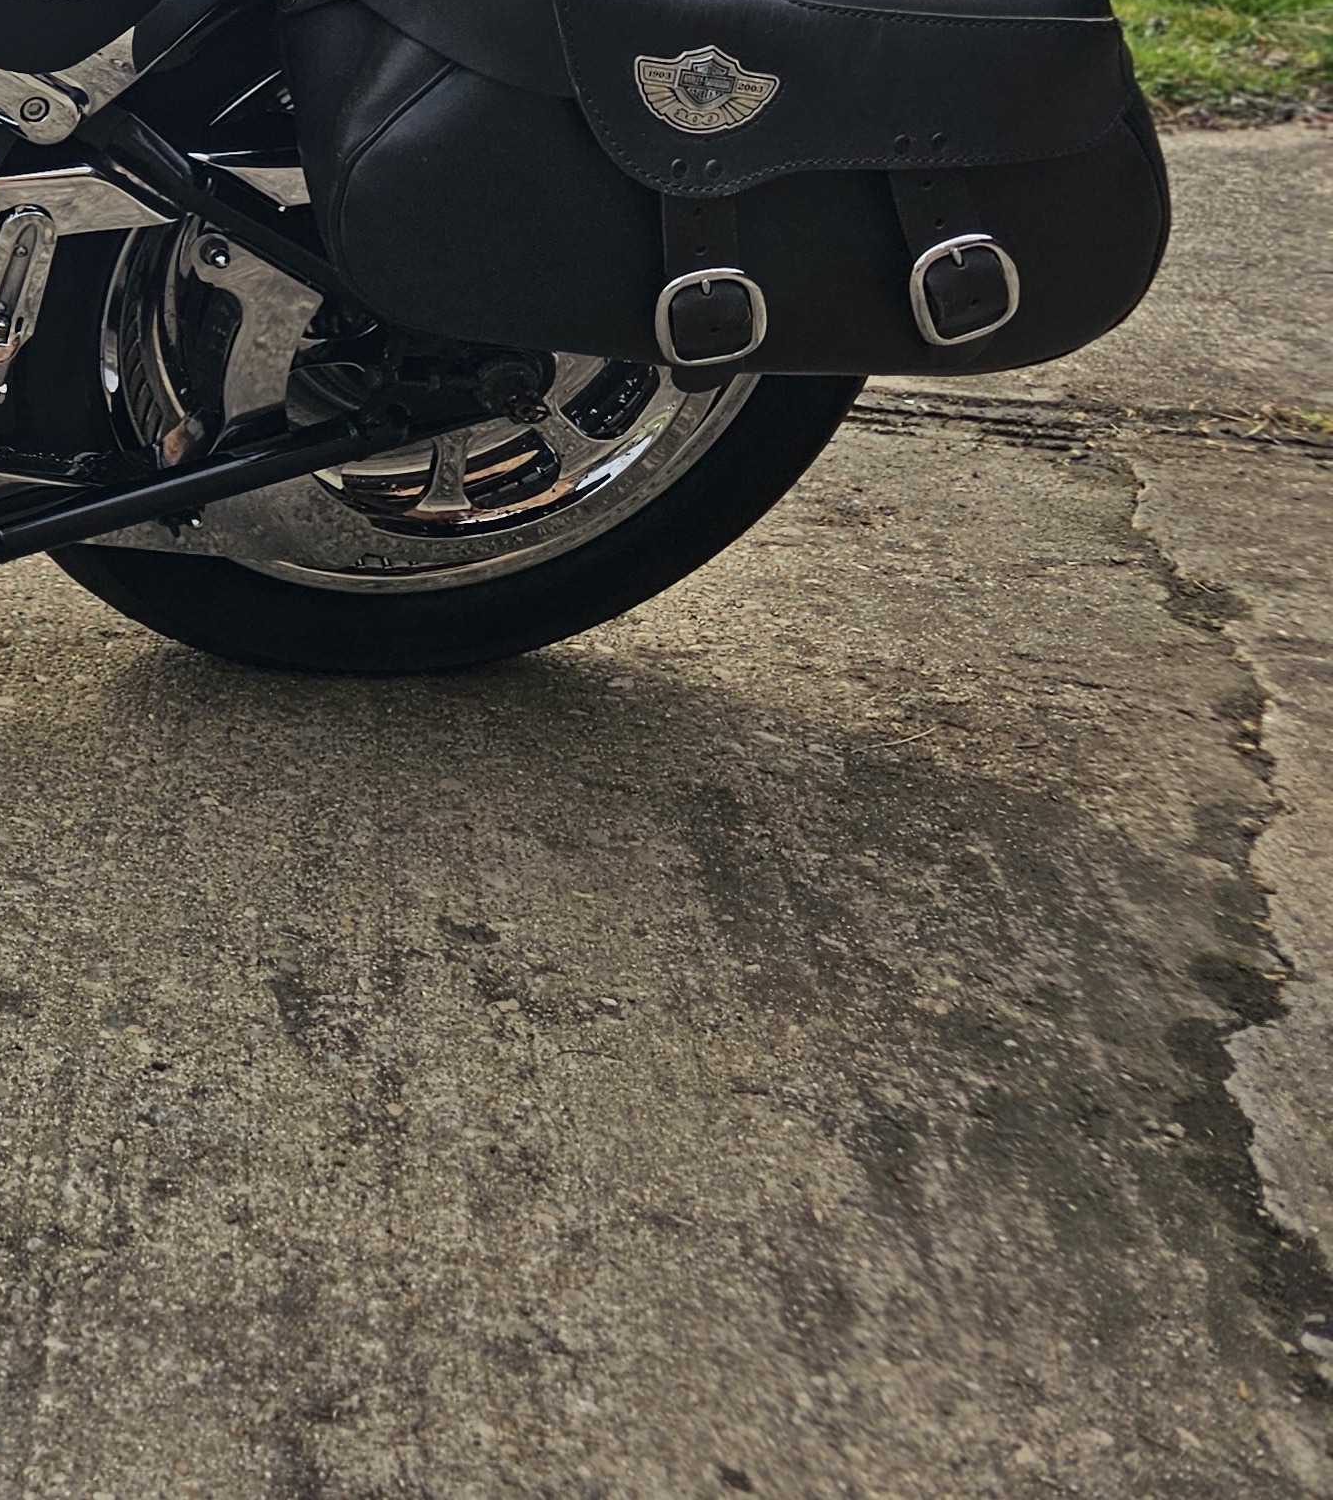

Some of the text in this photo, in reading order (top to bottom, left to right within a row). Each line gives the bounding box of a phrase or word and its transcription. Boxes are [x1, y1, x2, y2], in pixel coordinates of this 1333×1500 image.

[648, 69, 672, 80] 1903
[737, 83, 764, 93] 2003
[674, 108, 719, 126] 100
